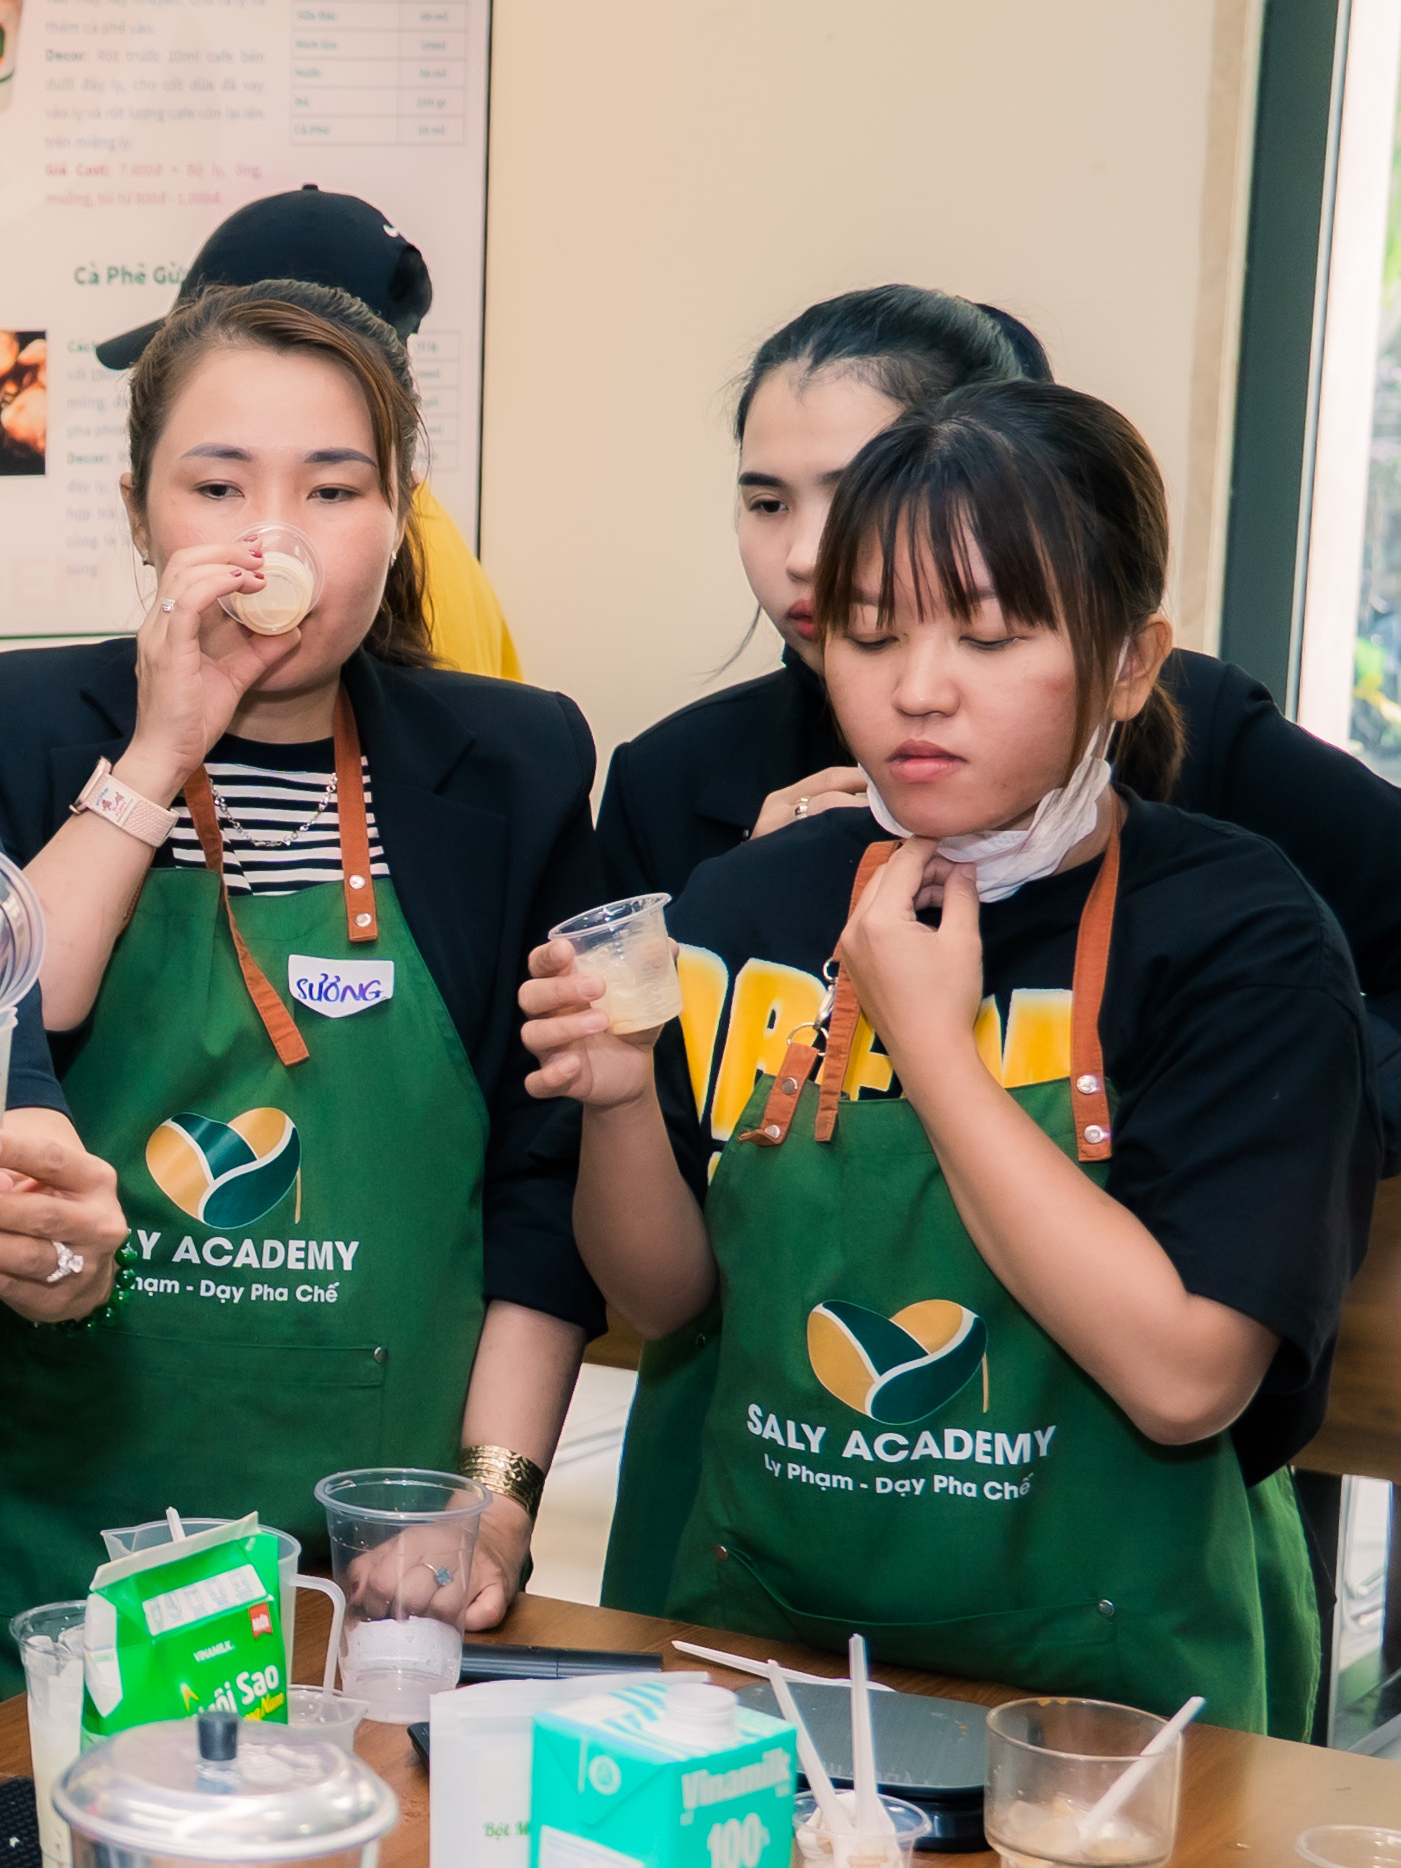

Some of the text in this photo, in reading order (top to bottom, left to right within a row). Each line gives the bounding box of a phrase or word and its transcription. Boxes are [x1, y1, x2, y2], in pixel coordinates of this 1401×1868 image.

[74, 262, 99, 285] Cà
[106, 263, 146, 285] Phê
[171, 1236, 360, 1271] ACADEMY
[130, 1276, 180, 1297] hạm
[200, 1280, 244, 1303] Dạy
[250, 1284, 289, 1302] Pha
[295, 1281, 340, 1303] Chế
[746, 1403, 1057, 1466] SALY ACADEMY
[764, 1453, 781, 1477] Ly
[787, 1463, 853, 1491] Phạm
[875, 1477, 925, 1497] Dạy
[933, 1475, 977, 1498] Pha
[983, 1472, 1034, 1500] Chế
[235, 1665, 279, 1706] Sao
